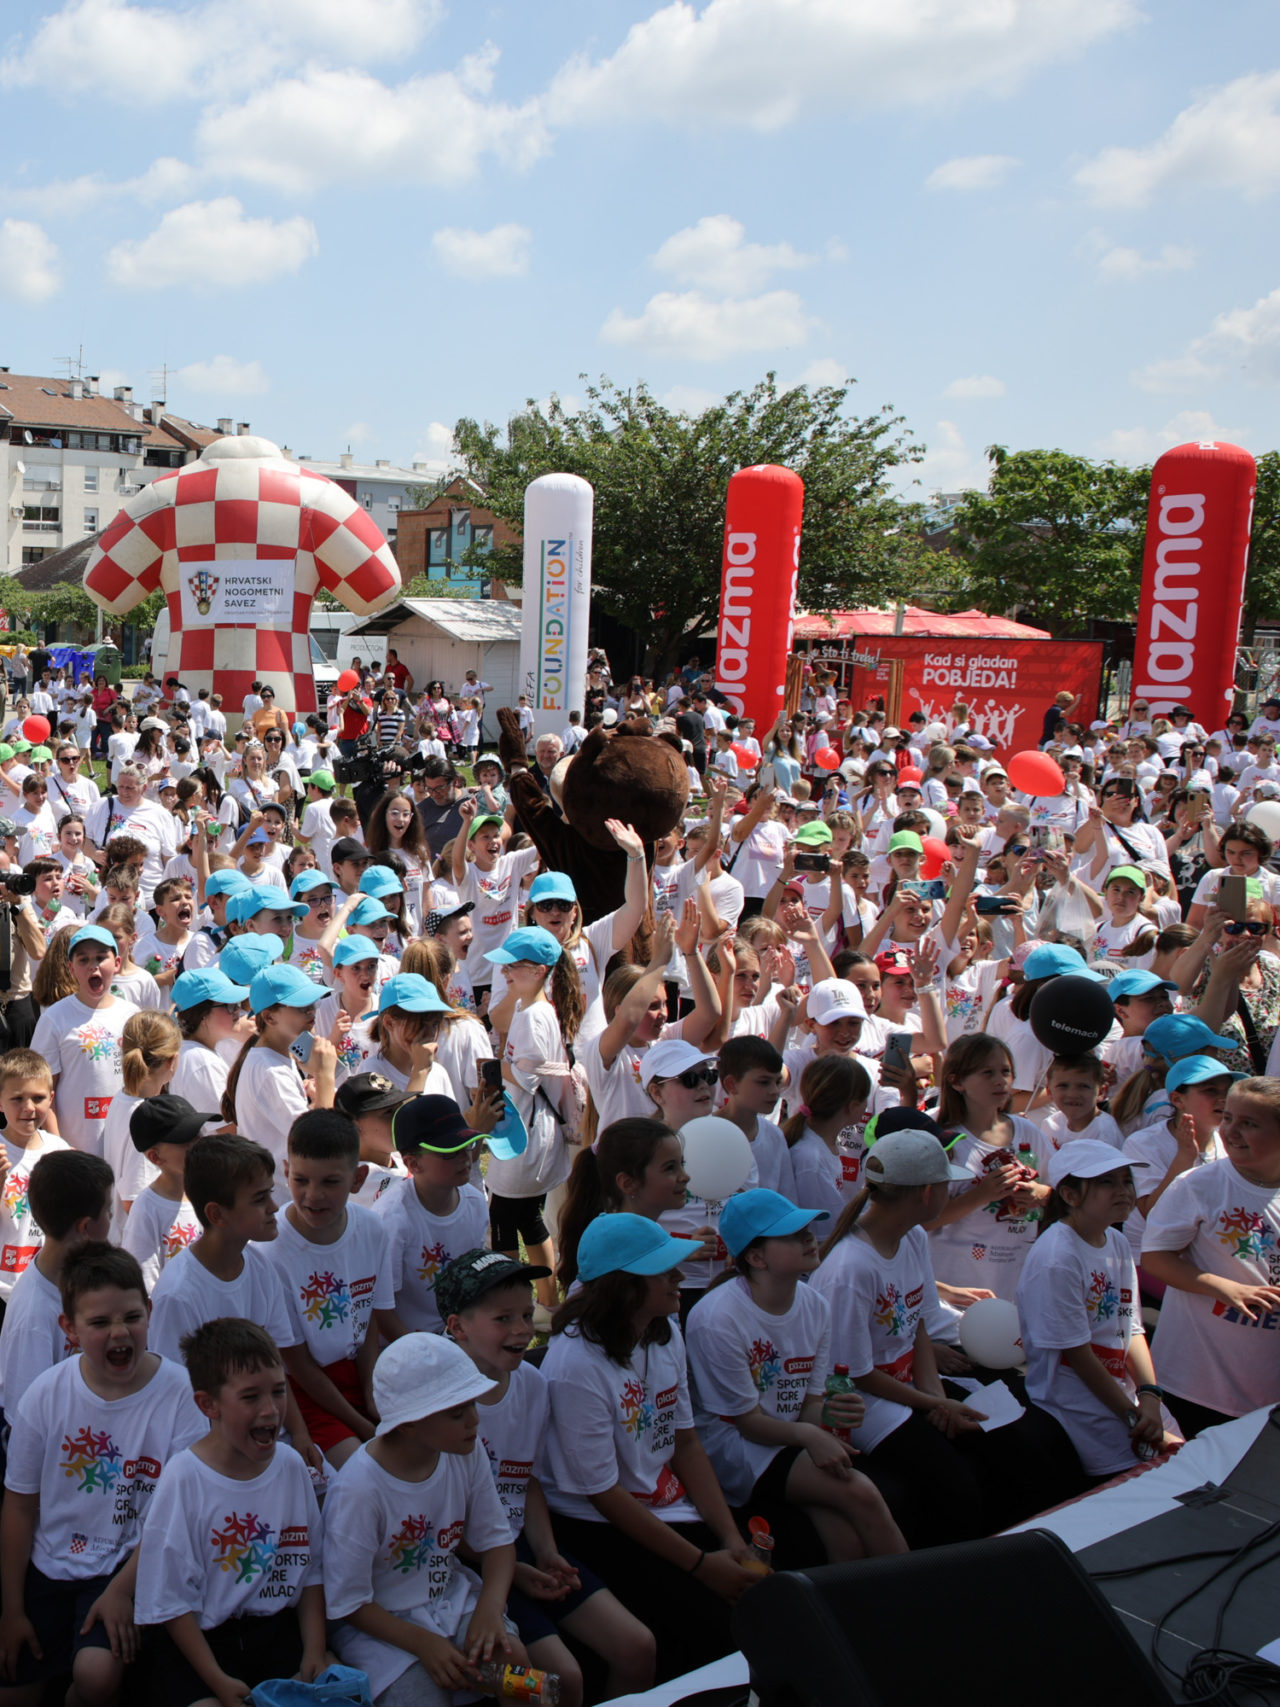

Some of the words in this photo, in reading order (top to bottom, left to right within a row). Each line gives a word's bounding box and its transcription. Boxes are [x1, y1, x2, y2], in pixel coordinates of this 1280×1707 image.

[574, 540, 584, 579] children
[224, 577, 272, 585] HRVATSKI
[224, 588, 284, 597] NOGOMETNI
[224, 599, 256, 608] SAVEZ
[1135, 493, 1206, 718] lazma
[543, 539, 566, 711] FOUNDATION
[822, 645, 837, 659] što
[840, 648, 849, 660] ti
[924, 653, 951, 666] Kad
[954, 654, 965, 667] si
[968, 654, 1017, 671] gladan
[922, 668, 1016, 688] POBJEDA!
[1051, 1019, 1098, 1038] telemach
[776, 1391, 799, 1401] IGRE
